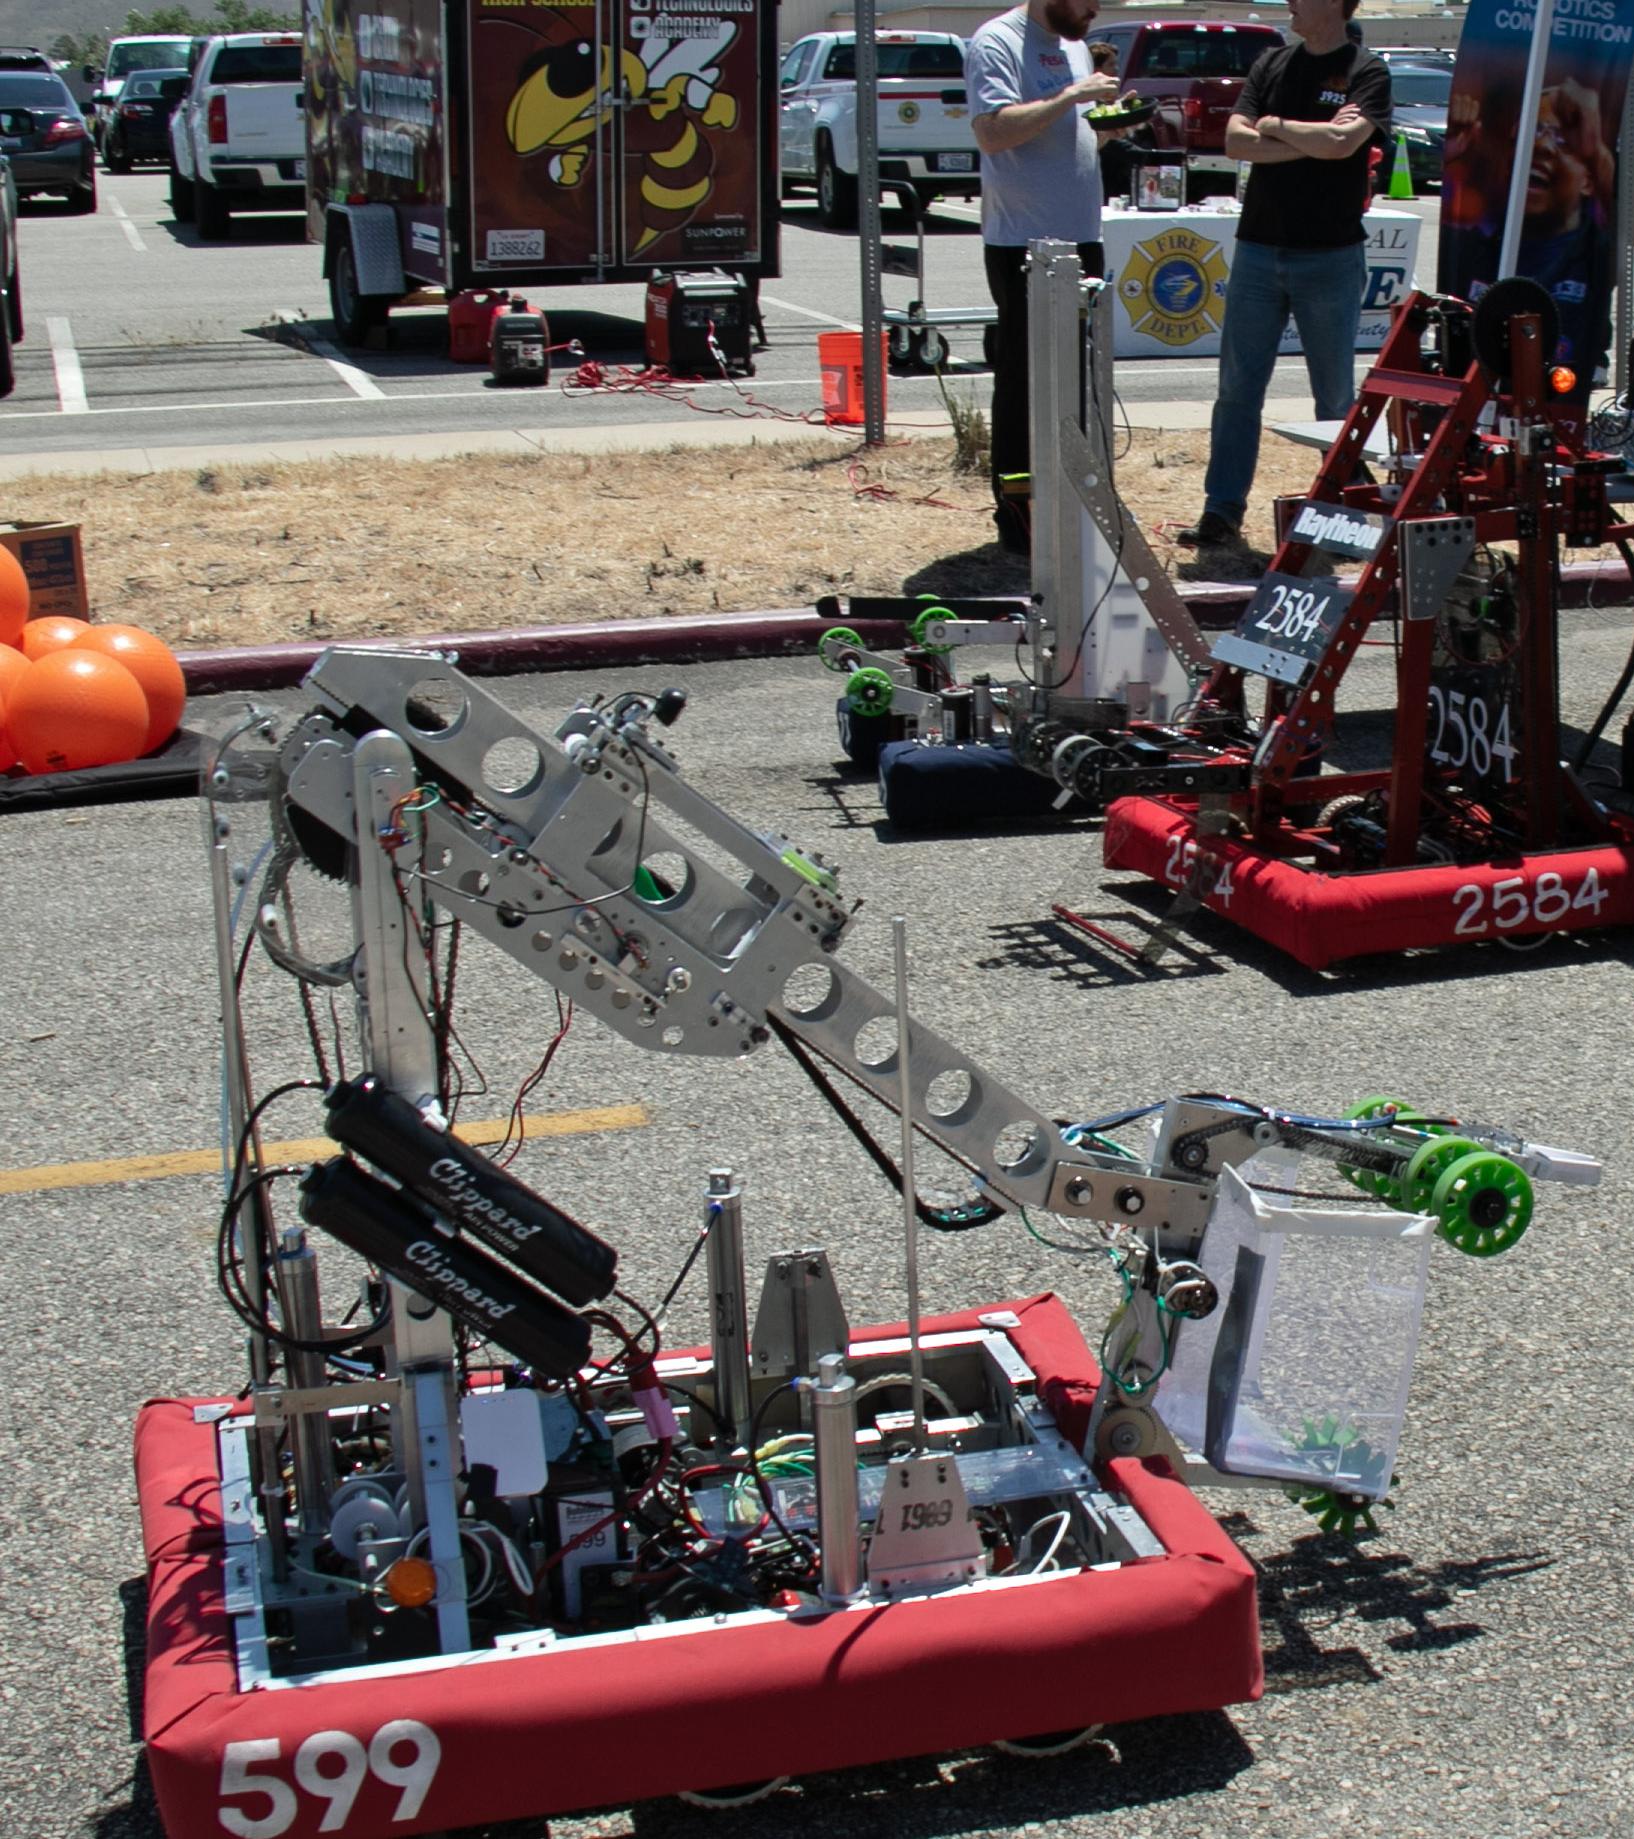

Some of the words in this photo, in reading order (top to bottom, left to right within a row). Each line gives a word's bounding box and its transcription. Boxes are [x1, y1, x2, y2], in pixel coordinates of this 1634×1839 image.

[1495, 9, 1633, 43] COMETITION
[685, 227, 747, 238] SUNPOWER
[1156, 235, 1199, 253] FIRE
[1293, 505, 1383, 551] Raytheon
[1255, 584, 1331, 643] 2584
[1428, 685, 1518, 783] 2584
[1452, 866, 1609, 936] 2584
[428, 1156, 543, 1242] Clippard
[404, 1240, 518, 1320] Clippard
[217, 1718, 442, 1839] 599
